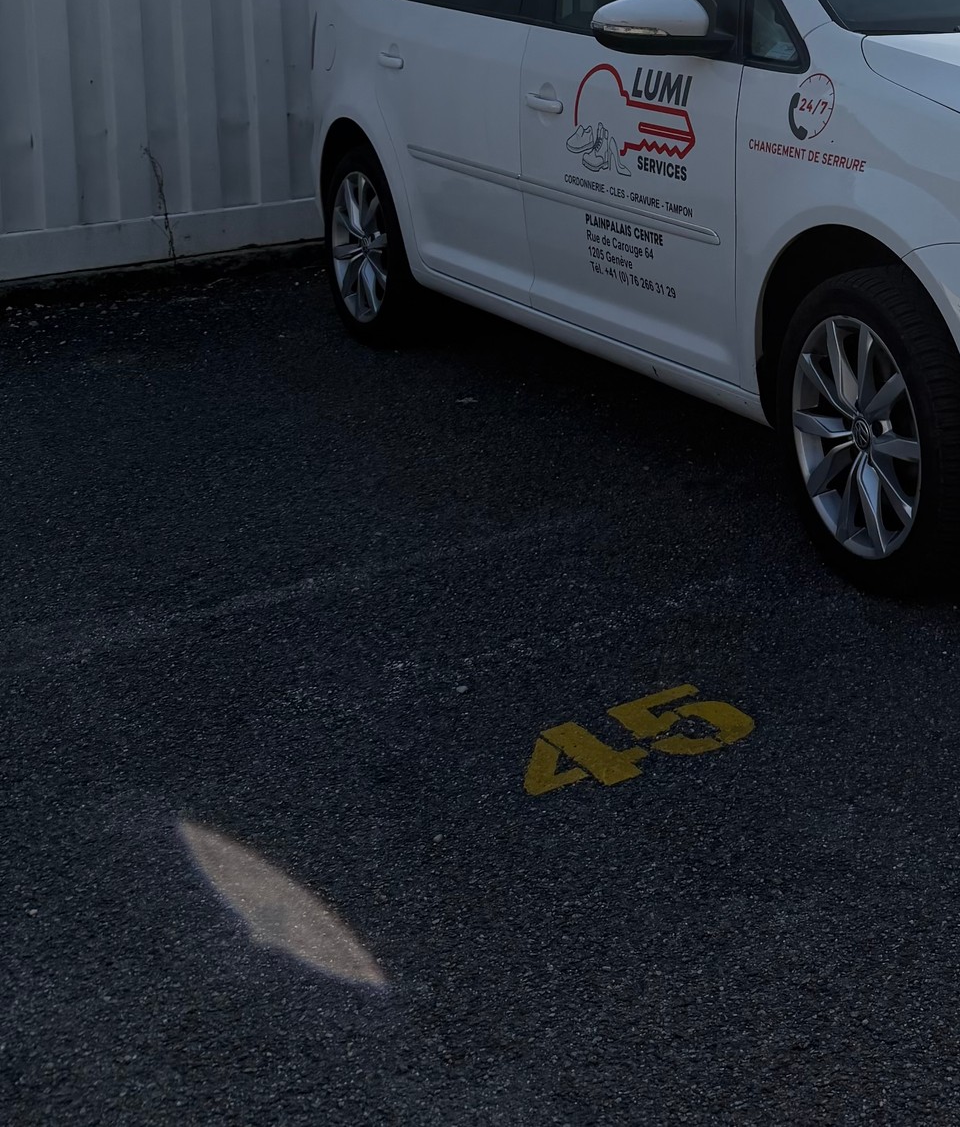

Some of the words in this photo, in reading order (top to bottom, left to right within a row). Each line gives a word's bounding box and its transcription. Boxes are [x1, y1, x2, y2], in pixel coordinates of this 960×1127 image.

[631, 67, 693, 107] LUMI
[799, 98, 828, 115] 24/7
[637, 155, 687, 182] SERVICES
[748, 139, 807, 160] CHANGEMENT
[808, 150, 819, 163] DE
[821, 153, 867, 173] SERRURE
[564, 174, 605, 194] CORDONNERIE
[609, 186, 626, 199] CLES
[630, 192, 660, 209] GRAVURE
[665, 201, 693, 218] TAMPON
[585, 213, 632, 237] PLAINPALAIS
[633, 227, 664, 246] CENTRE
[586, 229, 600, 243] Rue
[601, 235, 611, 247] de
[612, 237, 643, 258] Carouge
[644, 246, 654, 260] 64
[588, 246, 605, 260] 1205
[606, 251, 633, 269] Genève
[590, 261, 604, 275] Tél.
[605, 267, 617, 279] +41
[618, 271, 629, 286] (0)
[630, 274, 640, 287] 76
[640, 277, 655, 292] 266
[655, 282, 665, 296] 31
[665, 285, 677, 299] 29
[523, 683, 755, 796] 45
